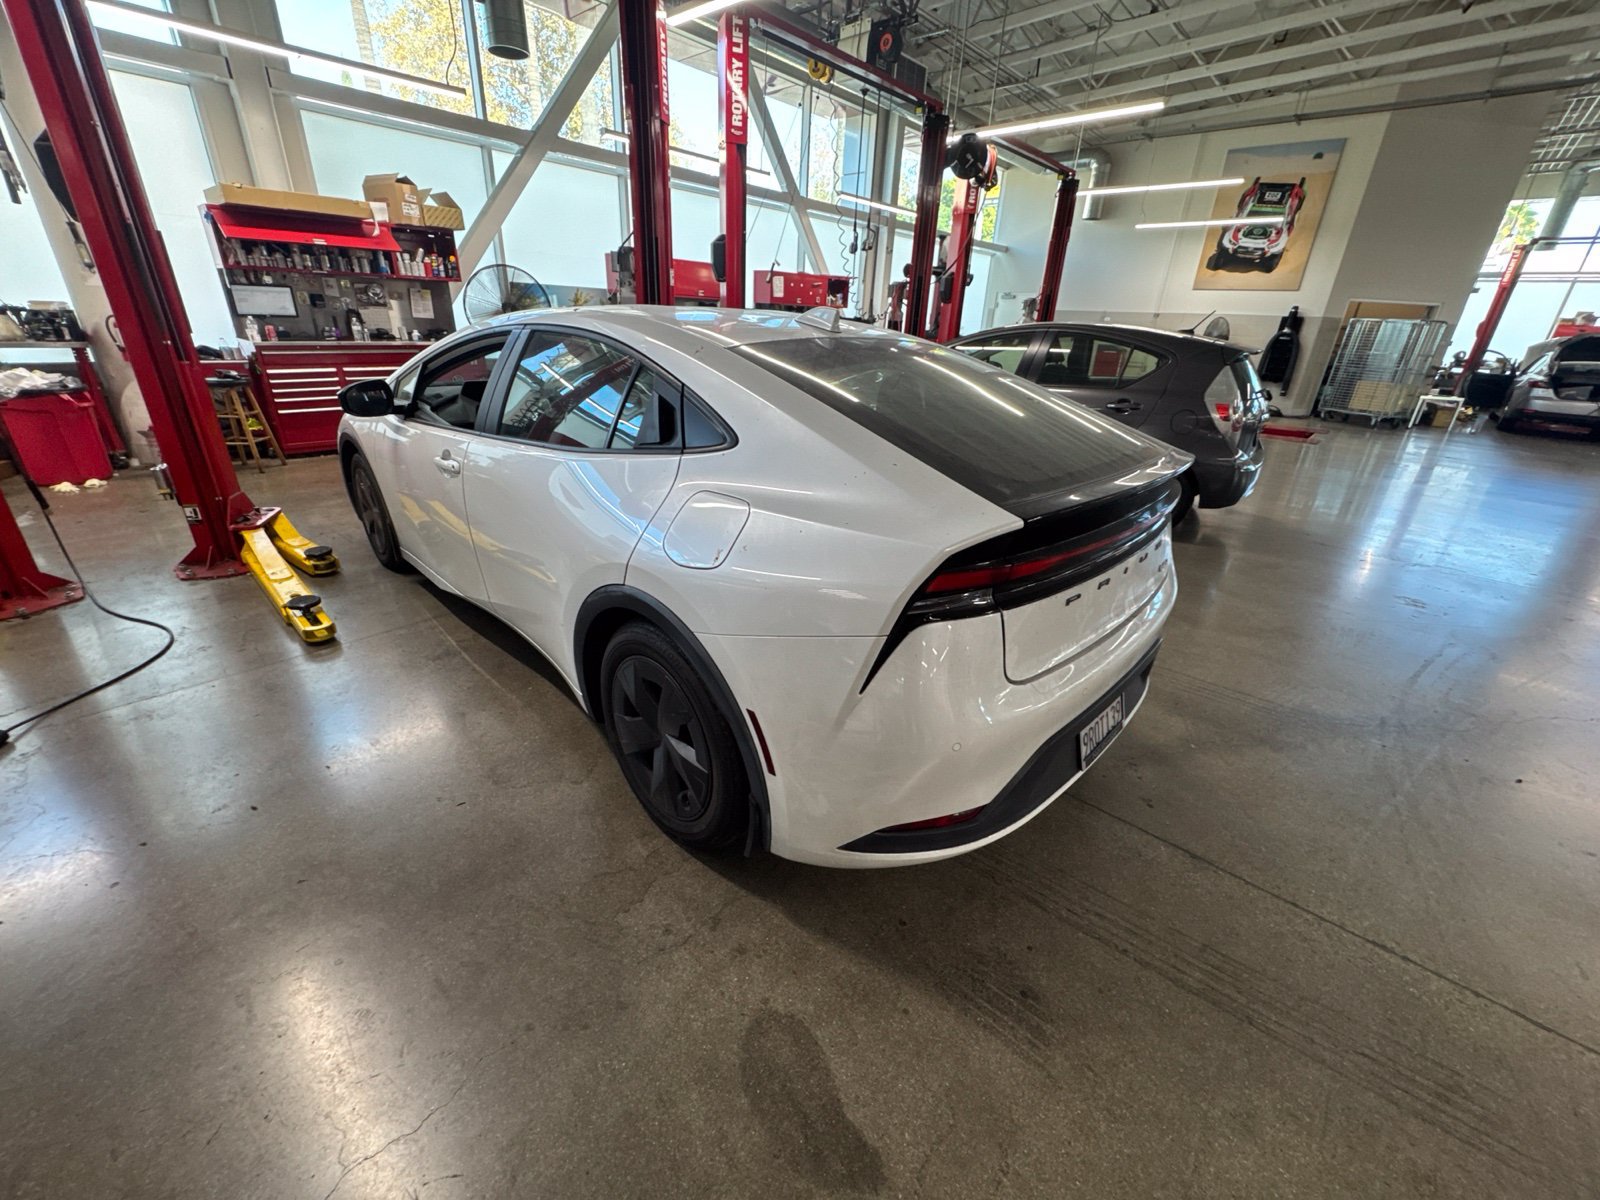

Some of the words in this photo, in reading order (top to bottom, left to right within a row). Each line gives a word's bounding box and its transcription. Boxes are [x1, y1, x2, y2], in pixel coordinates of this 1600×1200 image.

[660, 27, 668, 107] ROTARY
[732, 15, 744, 54] LIFT
[731, 58, 745, 127] ROTARY
